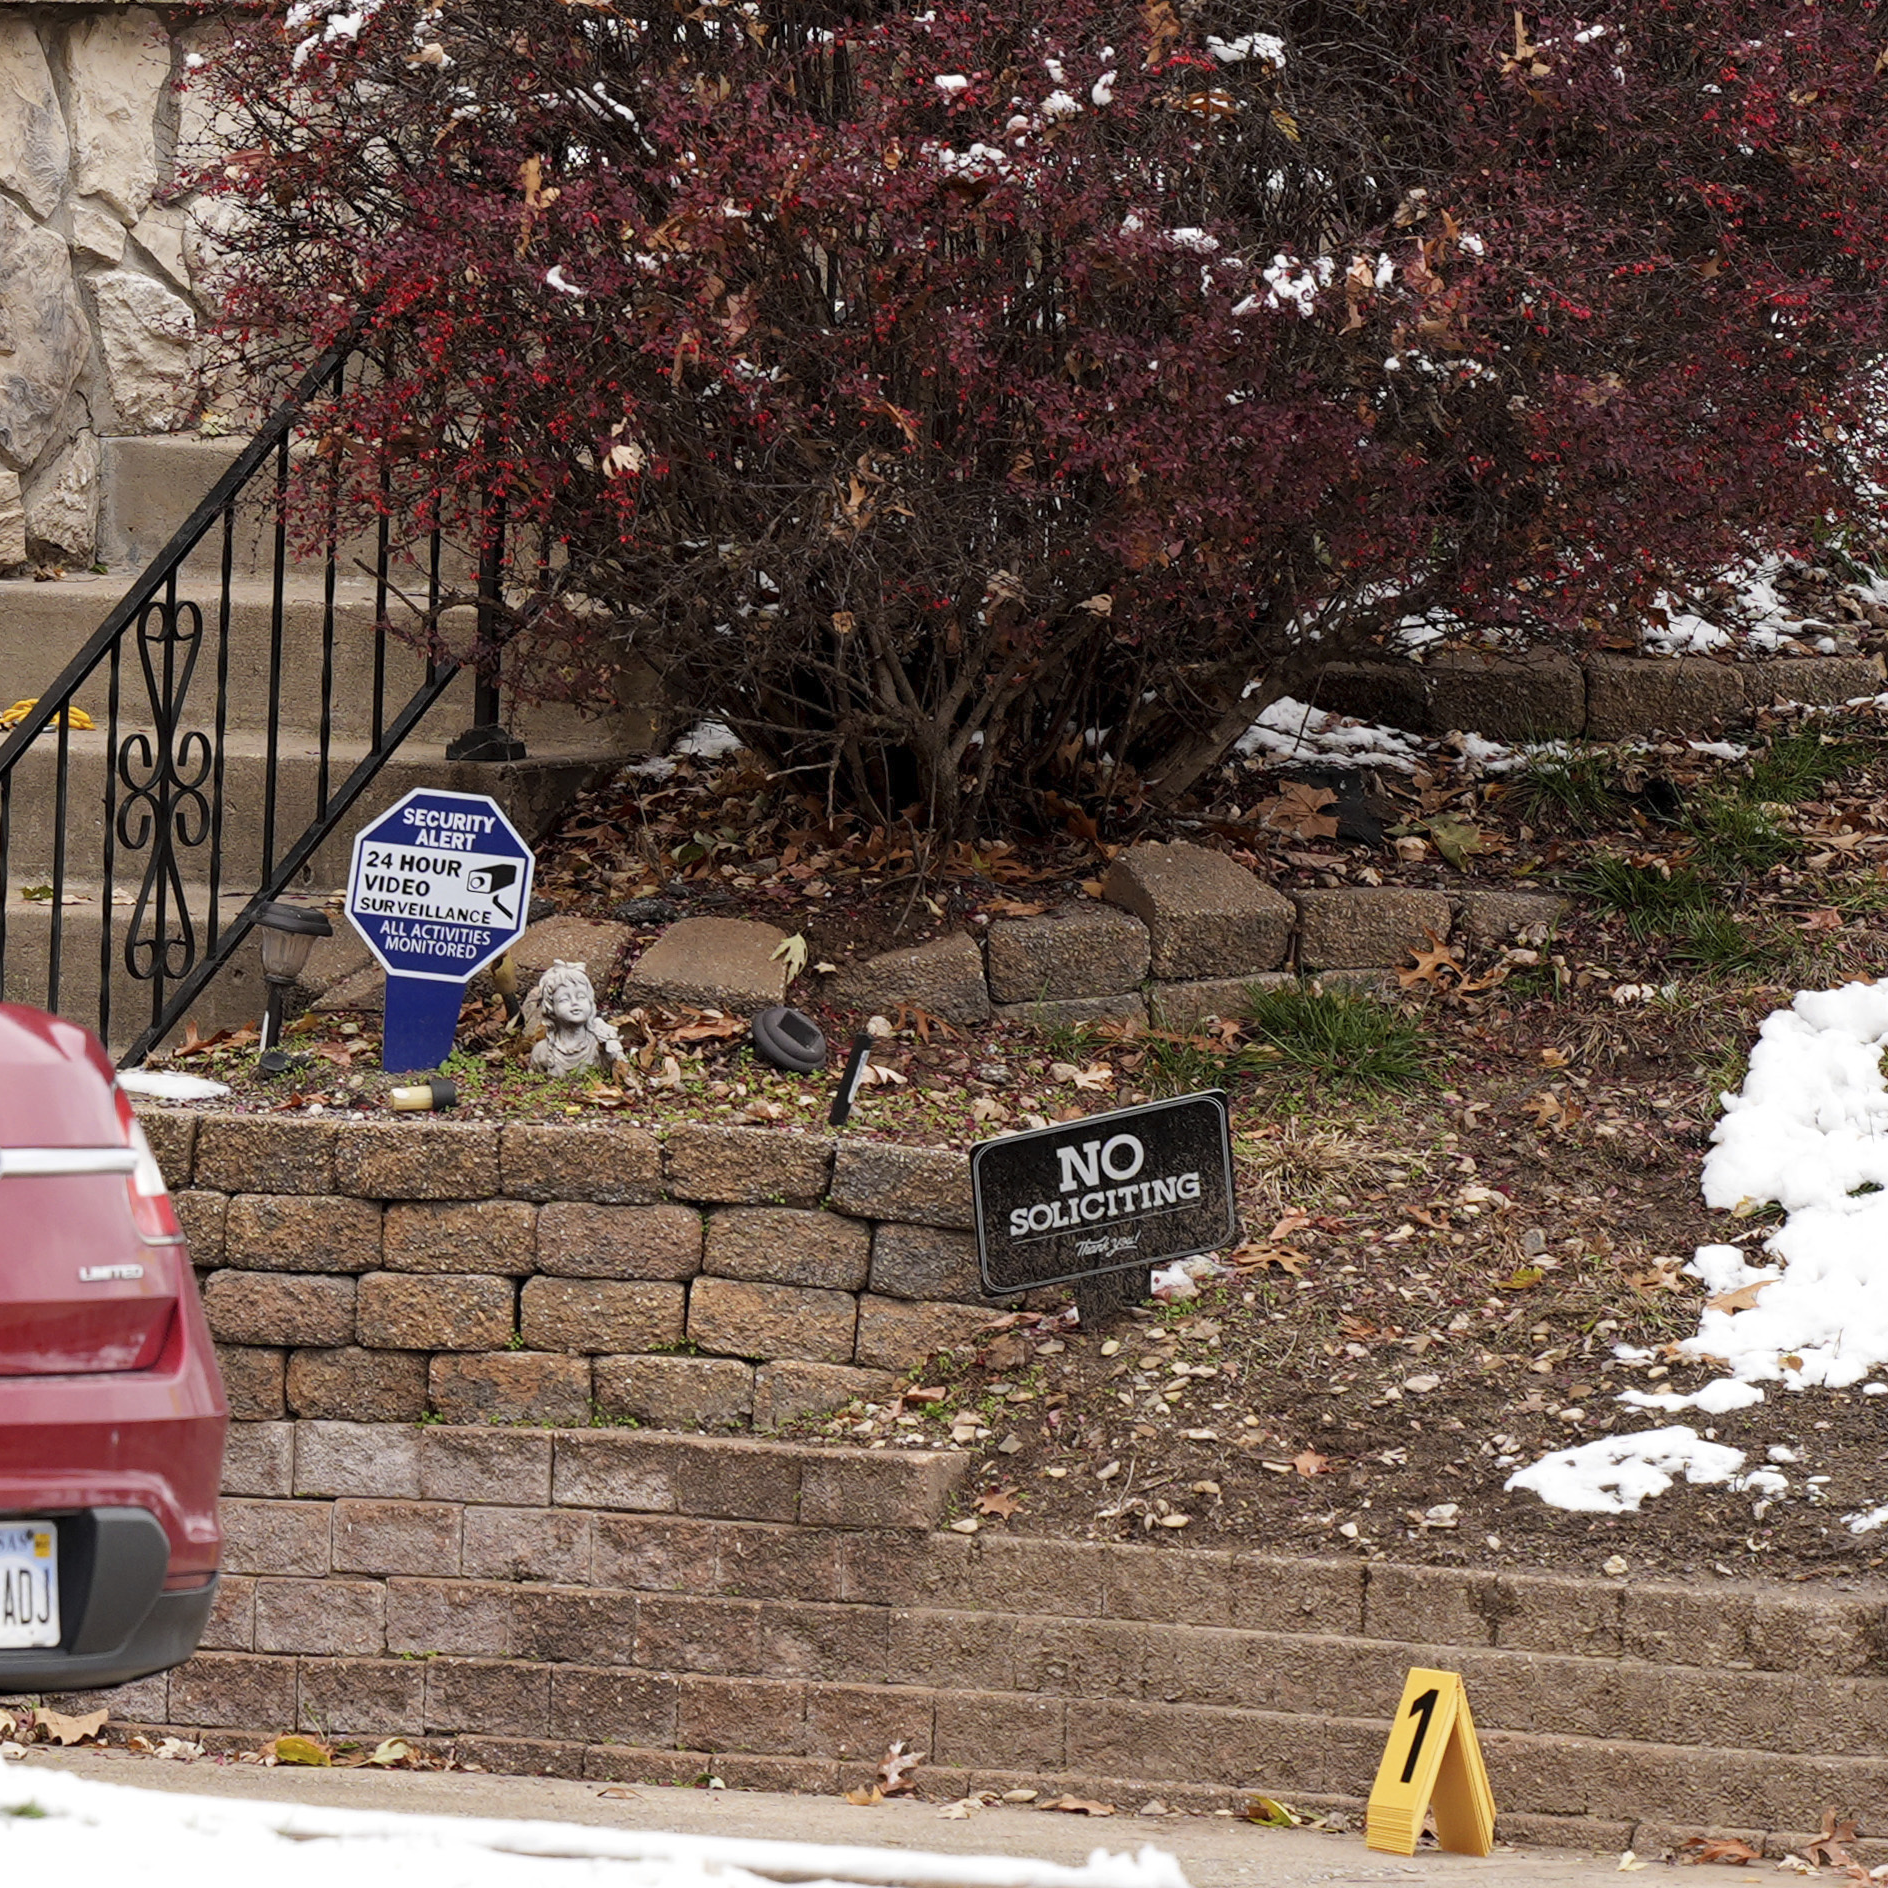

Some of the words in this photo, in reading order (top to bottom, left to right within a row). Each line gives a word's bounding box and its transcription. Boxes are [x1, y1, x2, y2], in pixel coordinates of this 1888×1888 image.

[402, 807, 496, 834] SECURITY
[415, 828, 477, 851] ALERT
[366, 851, 393, 869] 24
[400, 854, 462, 878] HOUR
[364, 874, 431, 897] VIDEO
[360, 897, 492, 925] SURVEILLANCE
[380, 920, 407, 937] ALL
[410, 925, 491, 945] ACTIVITIES
[385, 935, 477, 959] MONITORED
[1056, 1133, 1144, 1193] NO
[1009, 1172, 1201, 1237] SOLICITING
[1075, 1235, 1110, 1257] Thank
[1106, 1229, 1141, 1258] you!
[1400, 1689, 1439, 1784] 1
